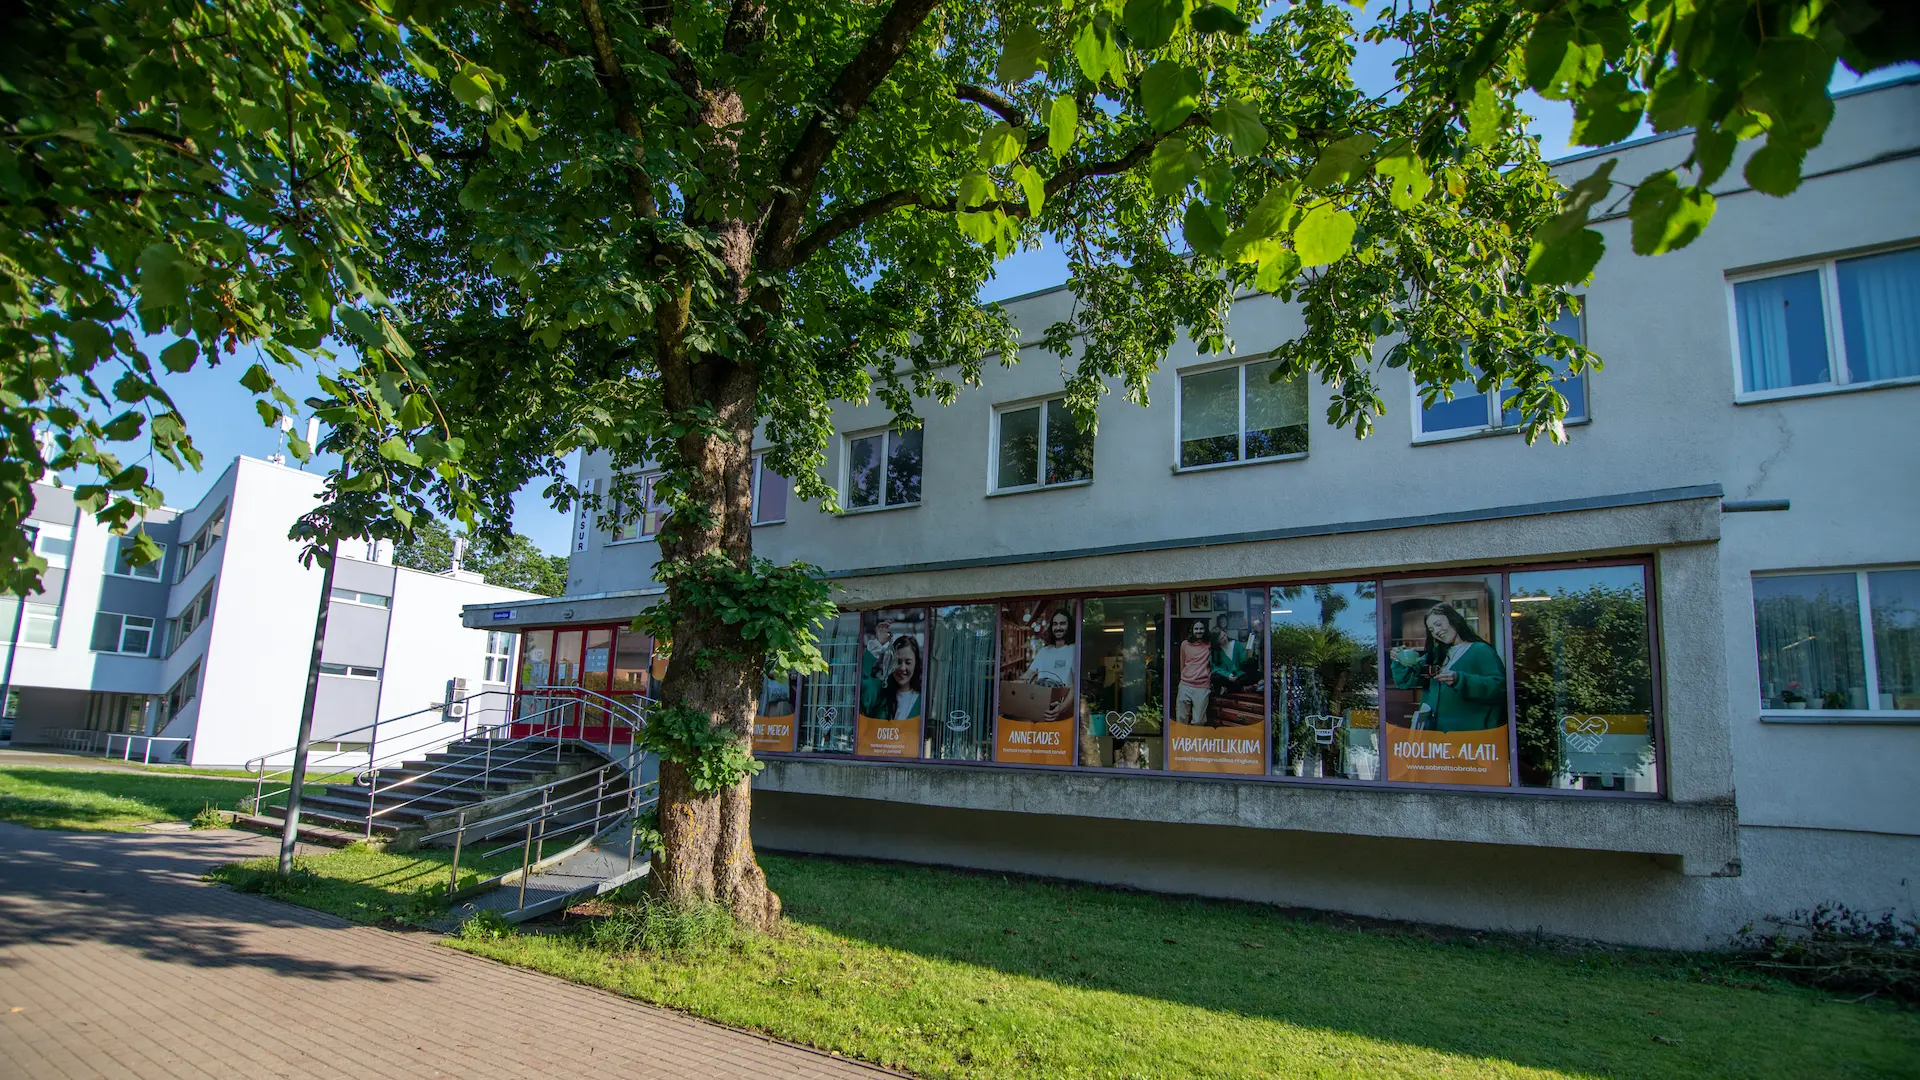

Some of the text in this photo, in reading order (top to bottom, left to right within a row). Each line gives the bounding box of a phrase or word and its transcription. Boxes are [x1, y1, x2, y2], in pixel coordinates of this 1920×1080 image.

[877, 727, 899, 740] OSTES
[1008, 730, 1060, 745] ANNETADES
[1172, 736, 1261, 754] VABATAHTLIKUNA
[1393, 741, 1499, 761] HOOLIME. ALATI.
